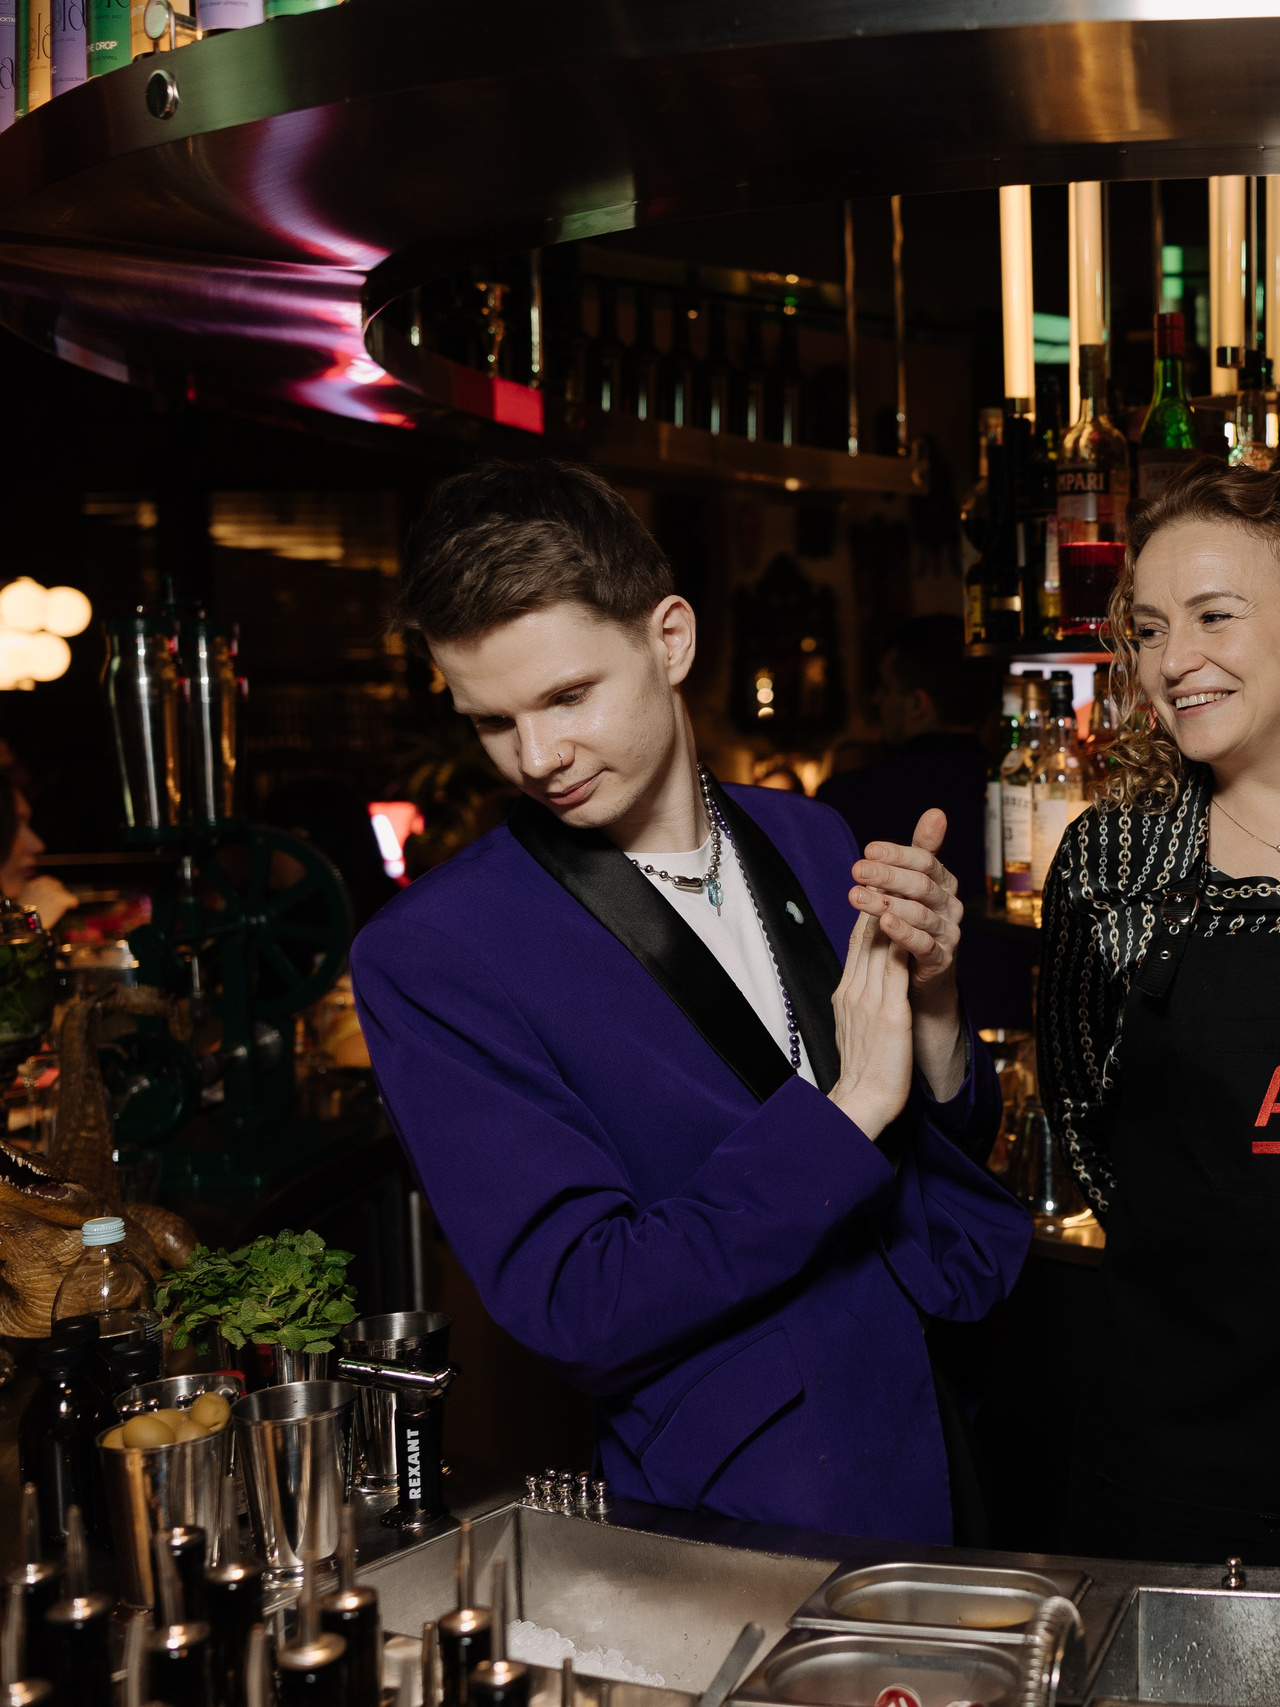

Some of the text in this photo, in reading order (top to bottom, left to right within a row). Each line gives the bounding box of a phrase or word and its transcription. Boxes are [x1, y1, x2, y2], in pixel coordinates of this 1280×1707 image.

[95, 41, 118, 51] DROP
[1057, 472, 1105, 491] MPARI
[406, 1428, 422, 1500] REXANT
